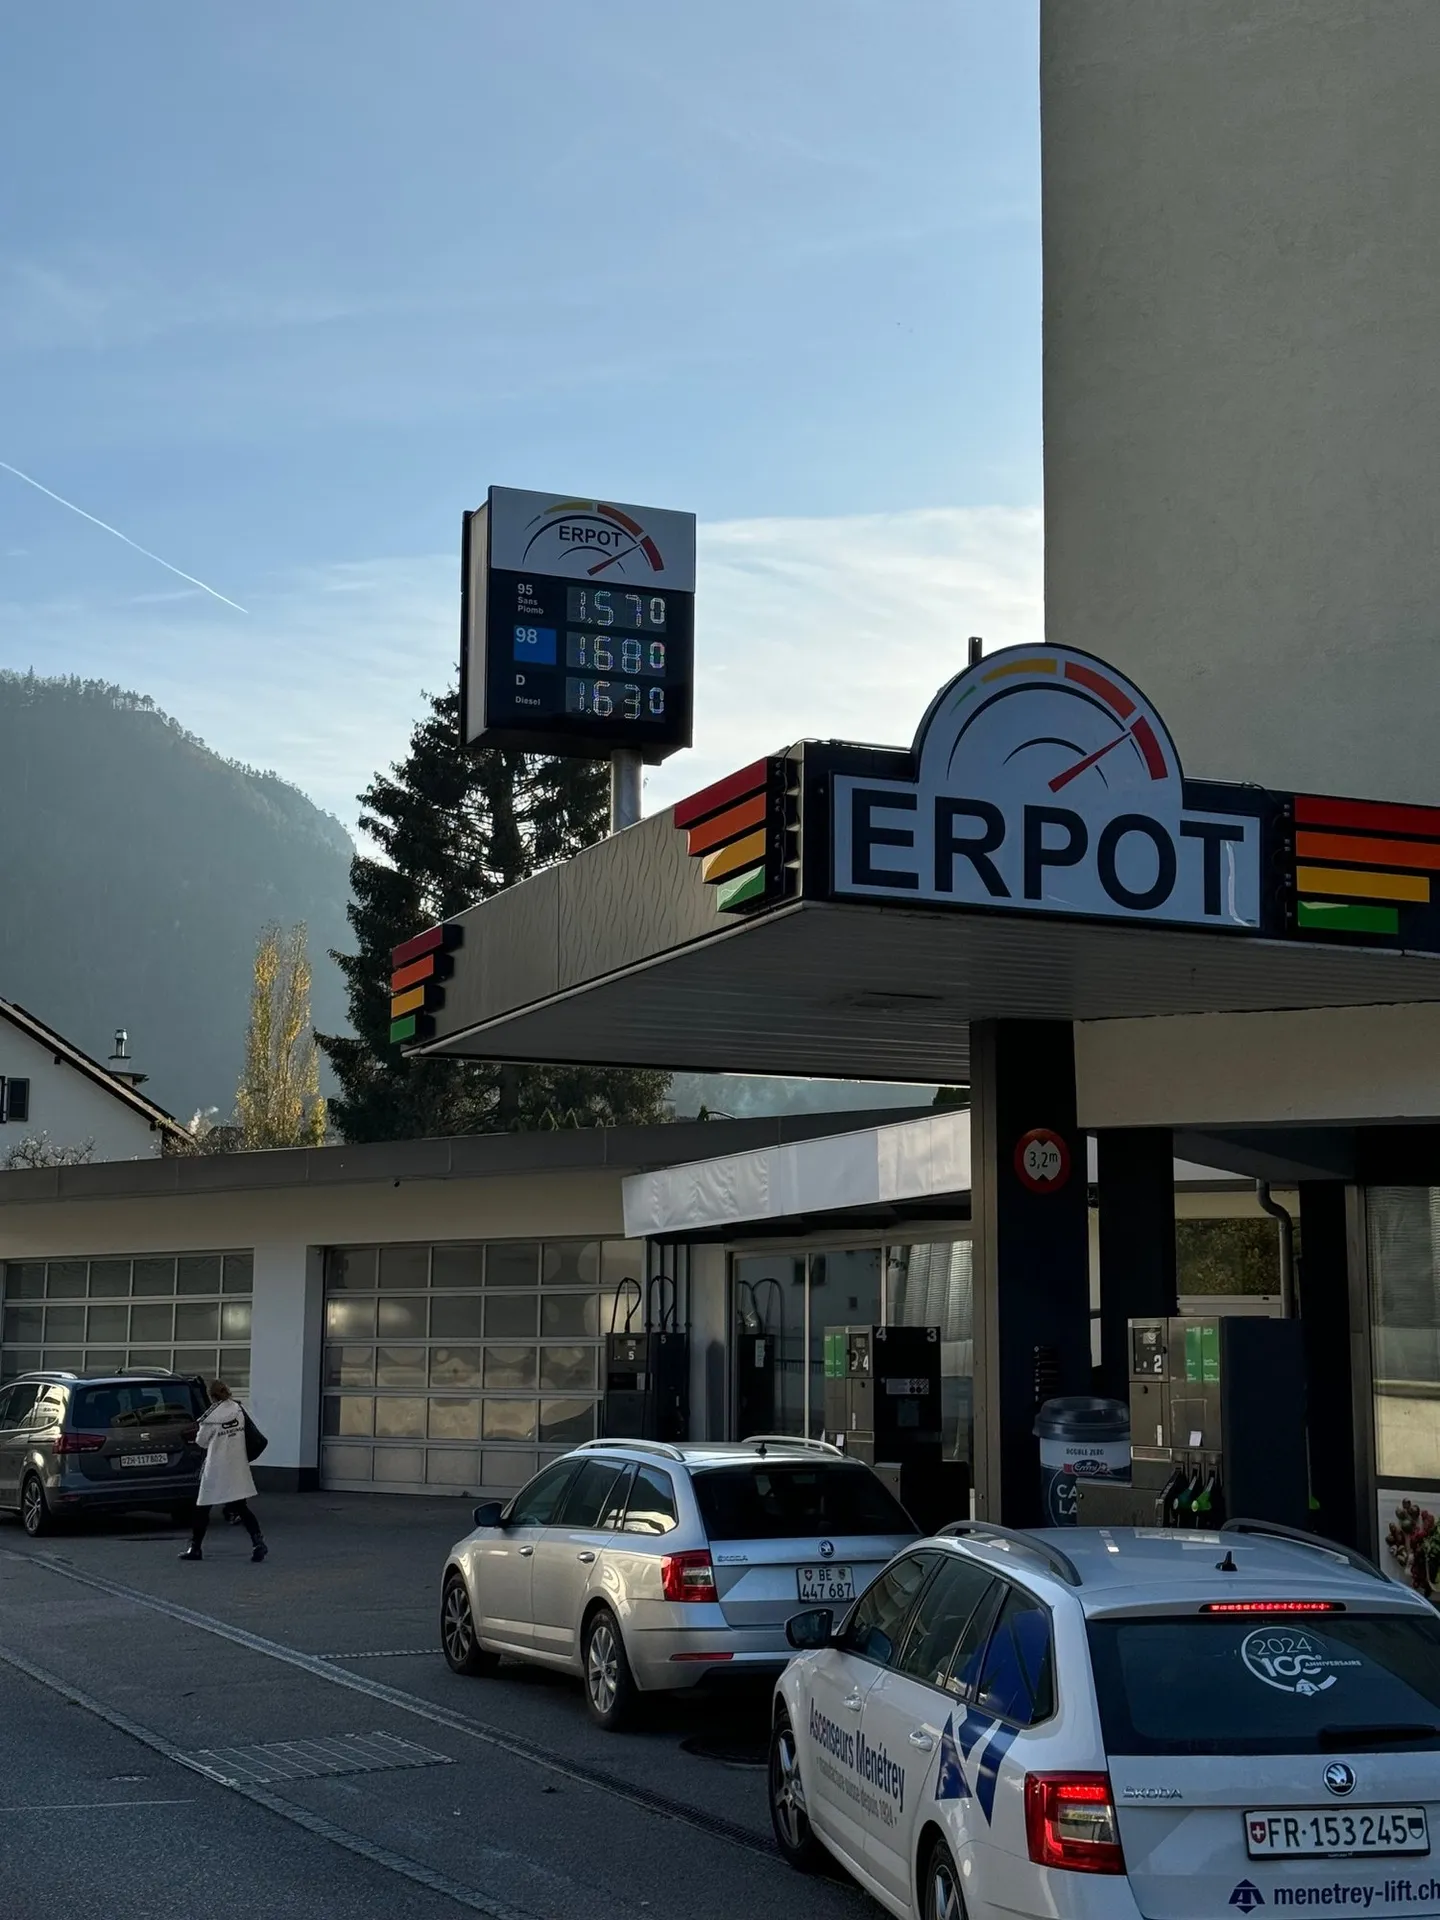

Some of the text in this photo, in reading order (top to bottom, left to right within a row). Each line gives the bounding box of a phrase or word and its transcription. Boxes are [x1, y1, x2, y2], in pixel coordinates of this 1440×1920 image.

[558, 525, 623, 547] ERPOT
[517, 583, 533, 595] 95
[517, 596, 538, 606] Sans
[517, 605, 544, 615] Plomb
[516, 627, 538, 644] 98
[515, 674, 526, 686] D
[515, 696, 541, 706] Diesel
[851, 787, 1245, 915] ERPOT
[661, 1334, 667, 1344] 5
[876, 1327, 887, 1341] 4
[927, 1328, 937, 1342] 3
[628, 1351, 635, 1360] 5
[862, 1355, 869, 1371] 4
[1153, 1354, 1162, 1373] 2
[818, 1569, 833, 1581] BE
[802, 1582, 851, 1599] 447 687
[1251, 1637, 1312, 1655] 2024
[810, 1697, 854, 1769] Ascenseurs
[856, 1729, 905, 1813] Menétrey
[1273, 1878, 1440, 1908] menetrey-lift.ch
